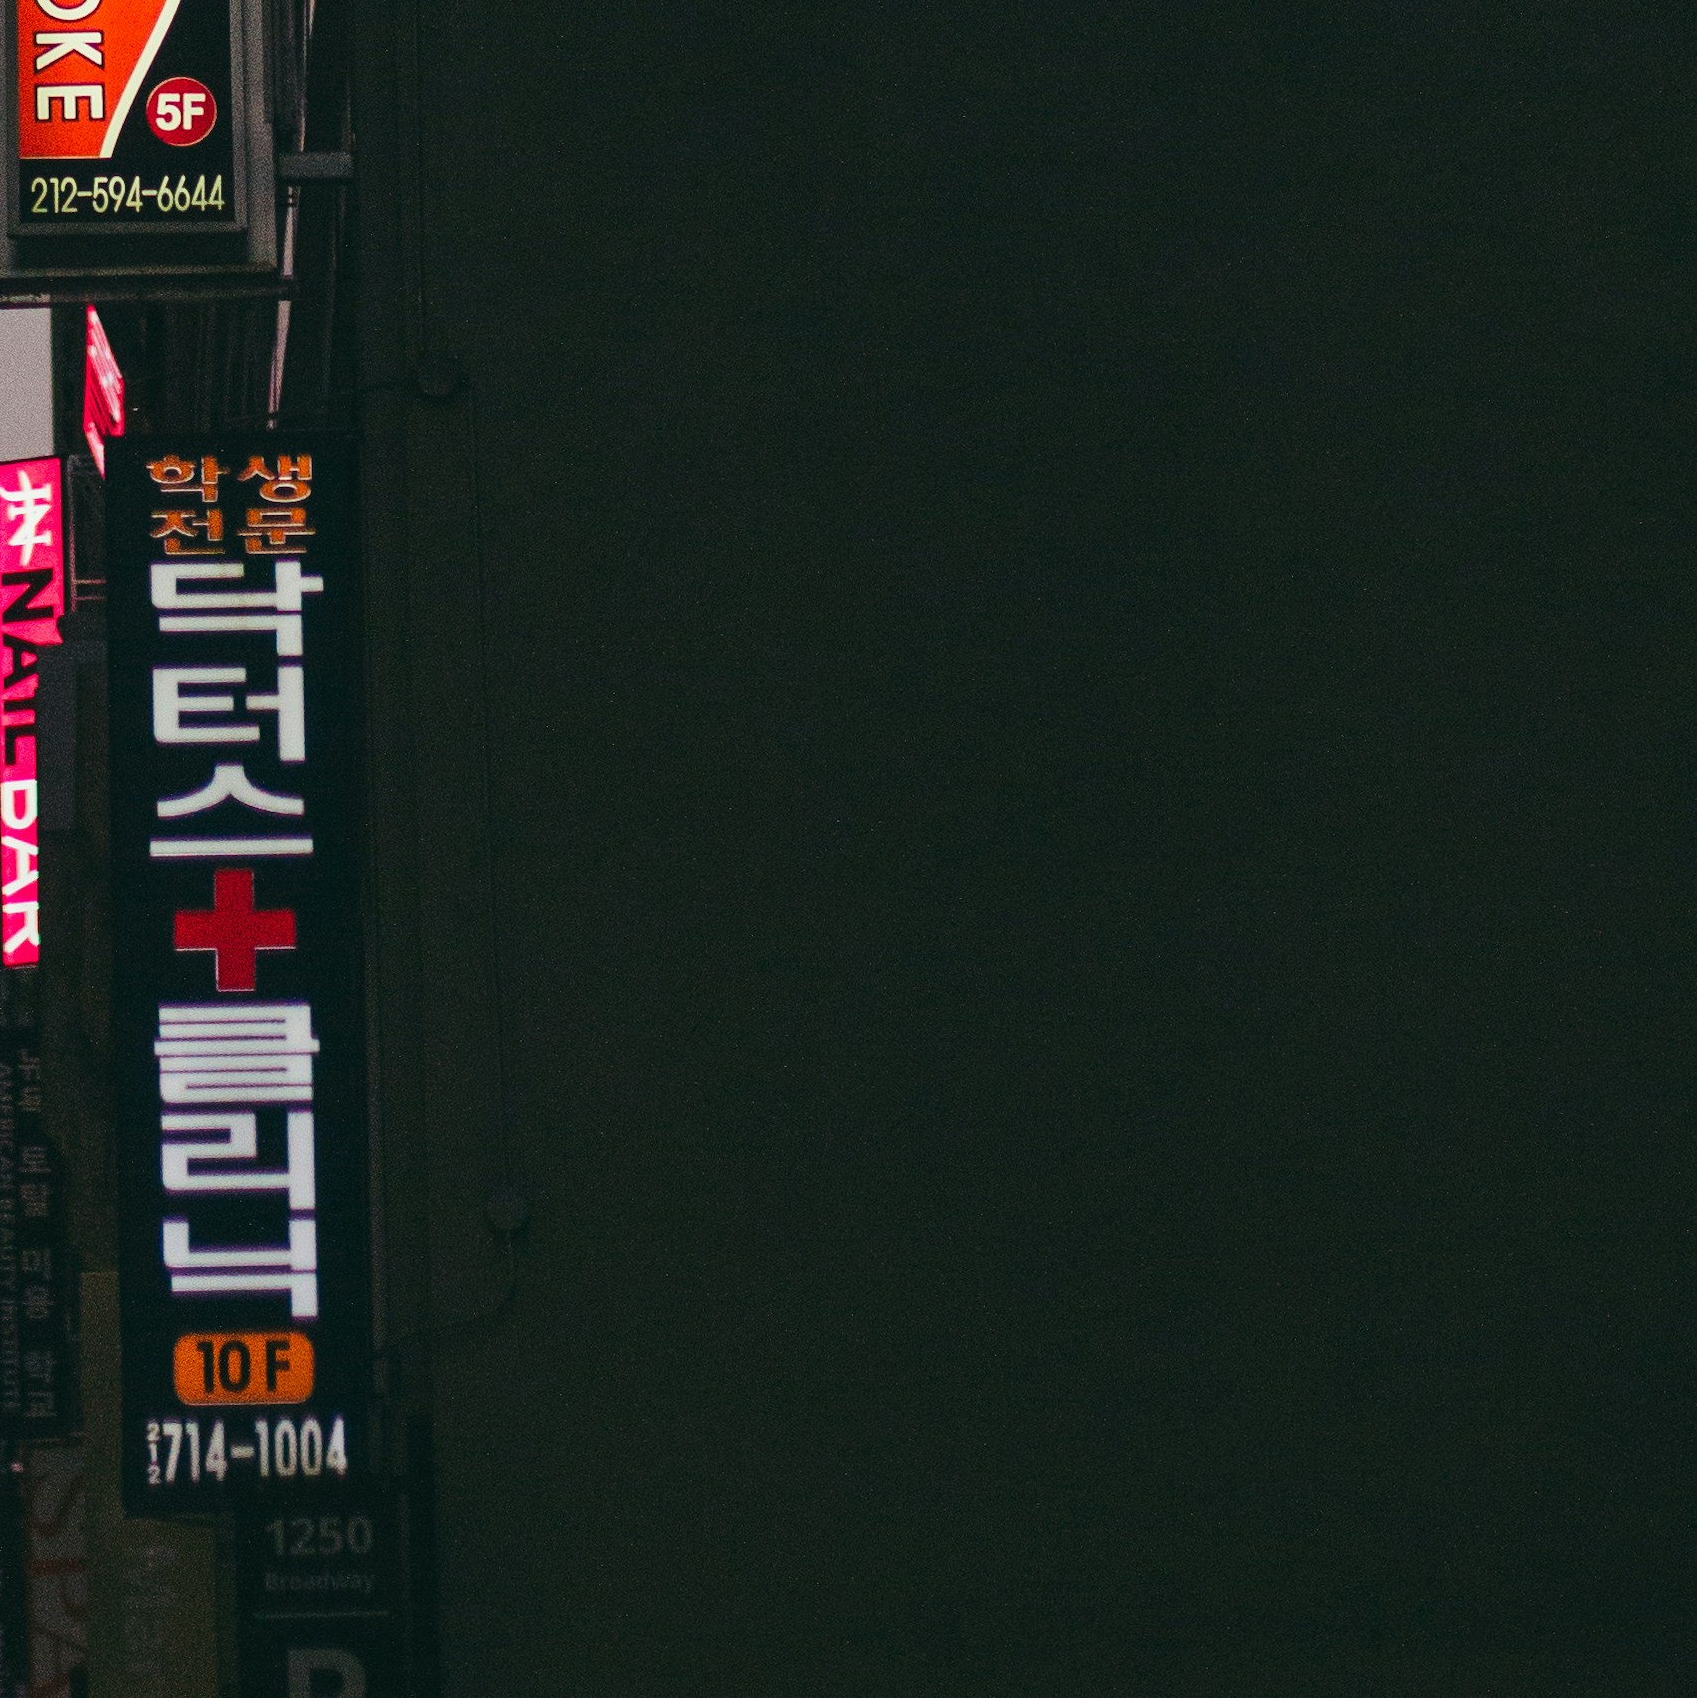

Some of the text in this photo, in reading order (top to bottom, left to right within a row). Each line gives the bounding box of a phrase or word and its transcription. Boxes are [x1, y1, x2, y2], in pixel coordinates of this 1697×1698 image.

[155, 93, 207, 132] 5F
[31, 174, 225, 214] 212-594-6644
[146, 455, 312, 503] 학생
[150, 508, 316, 555] 전문
[2, 569, 54, 765] NAIL
[1, 778, 41, 954] BAR
[149, 561, 324, 1318] 닥터스 클리닉
[197, 1339, 290, 1394] 10 F
[147, 1415, 348, 1484] 212 714-1004
[265, 1515, 373, 1556] 1250
[264, 1570, 375, 1594] Broadway
